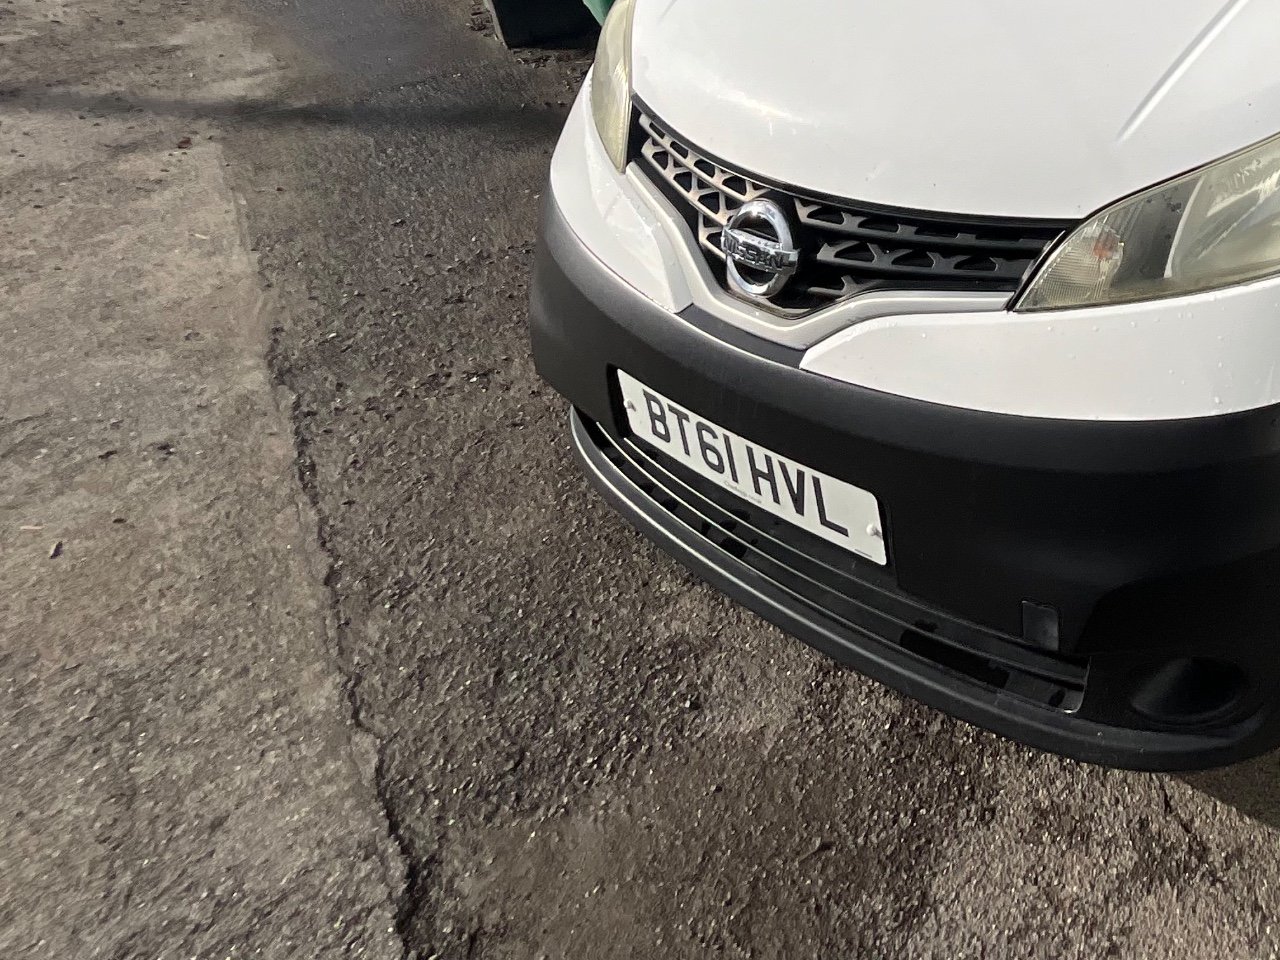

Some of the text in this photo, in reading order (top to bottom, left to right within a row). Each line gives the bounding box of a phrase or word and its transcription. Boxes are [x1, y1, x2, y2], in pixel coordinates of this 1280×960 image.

[721, 235, 785, 271] NISSAN
[642, 388, 849, 537] BT61 HVL
